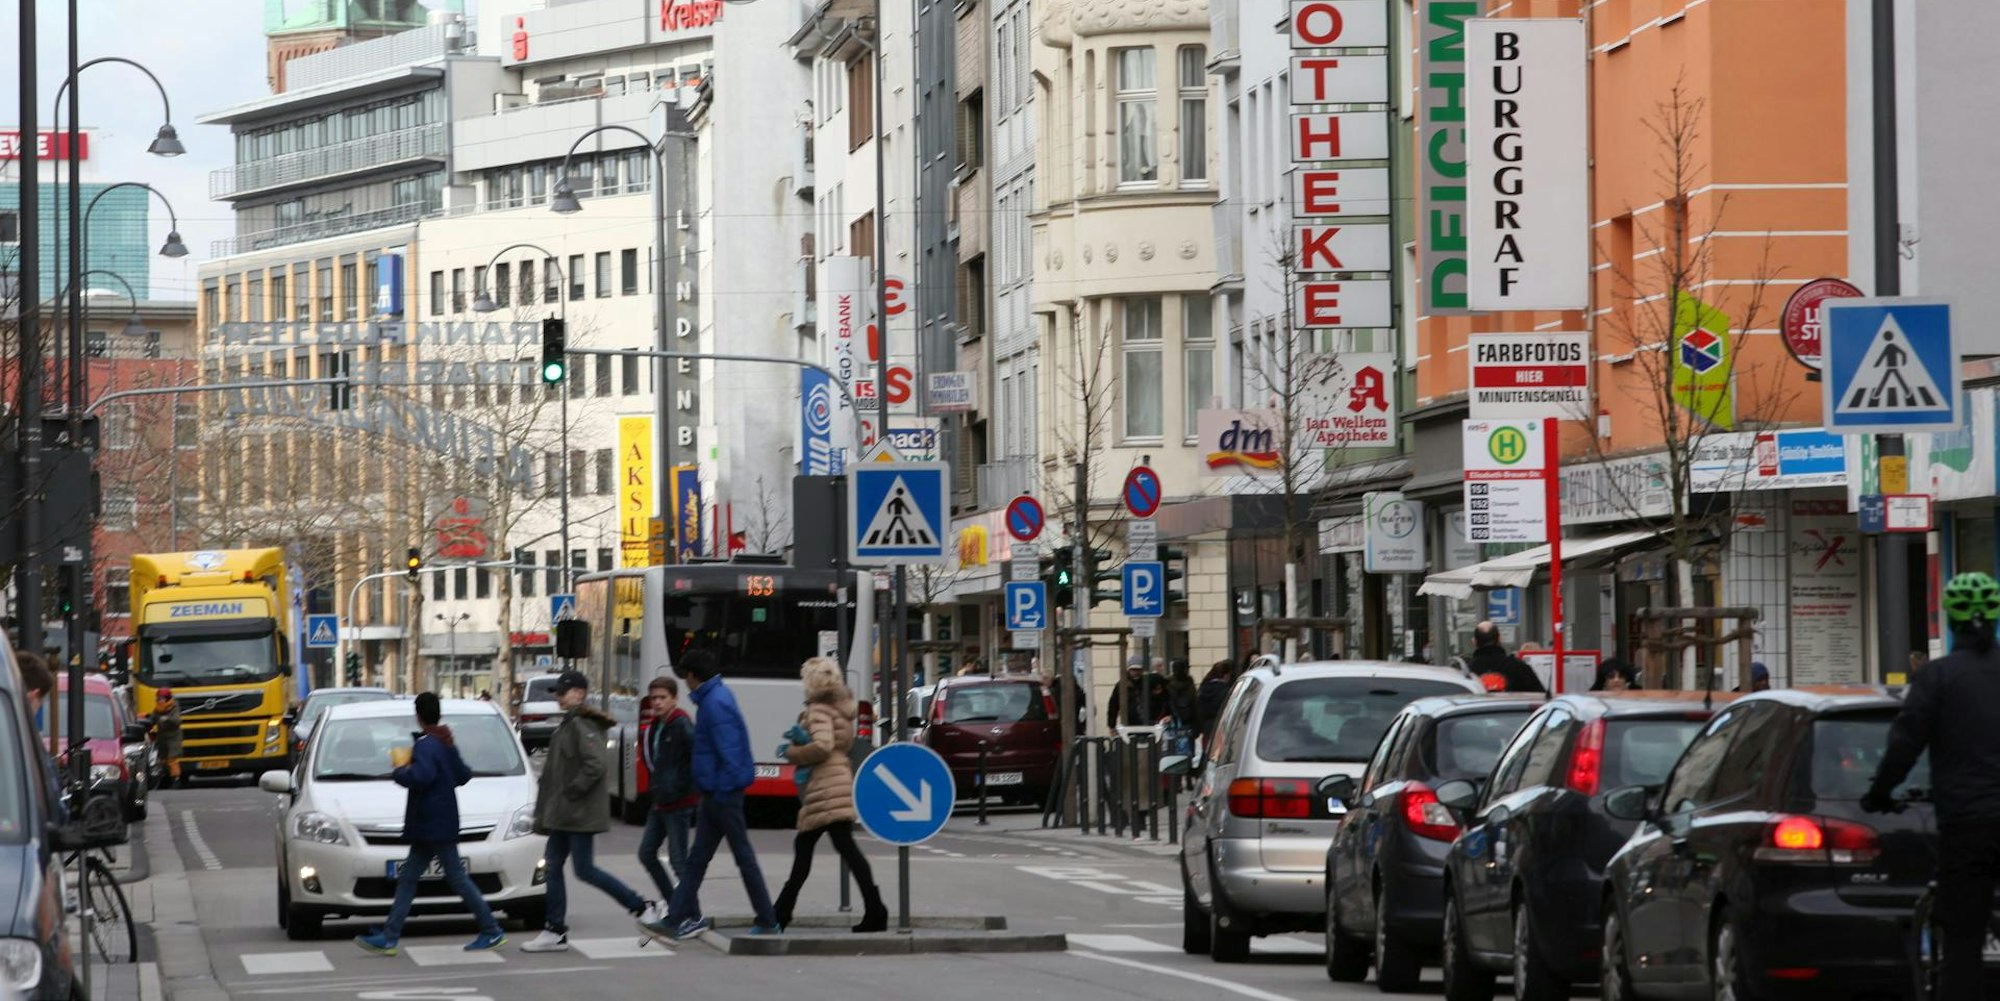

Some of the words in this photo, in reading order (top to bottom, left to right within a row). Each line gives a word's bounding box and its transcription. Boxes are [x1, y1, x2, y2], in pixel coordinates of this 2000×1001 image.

[1493, 32, 1524, 297] BURGGRAF
[838, 295, 851, 338] BANK
[676, 209, 693, 464] LINDENB
[1477, 343, 1581, 362] FARBFOTOS
[1516, 370, 1544, 383] HIER
[1478, 390, 1584, 403] MINUTENSCHNELL
[1306, 418, 1329, 431] Jan
[1333, 415, 1386, 428] Wellem
[1219, 420, 1272, 452] dm
[1316, 429, 1388, 445] Apotheke
[1472, 485, 1487, 495] 151
[1472, 499, 1487, 509] 152
[747, 575, 774, 596] 153
[171, 603, 242, 617] ZEEMAN
